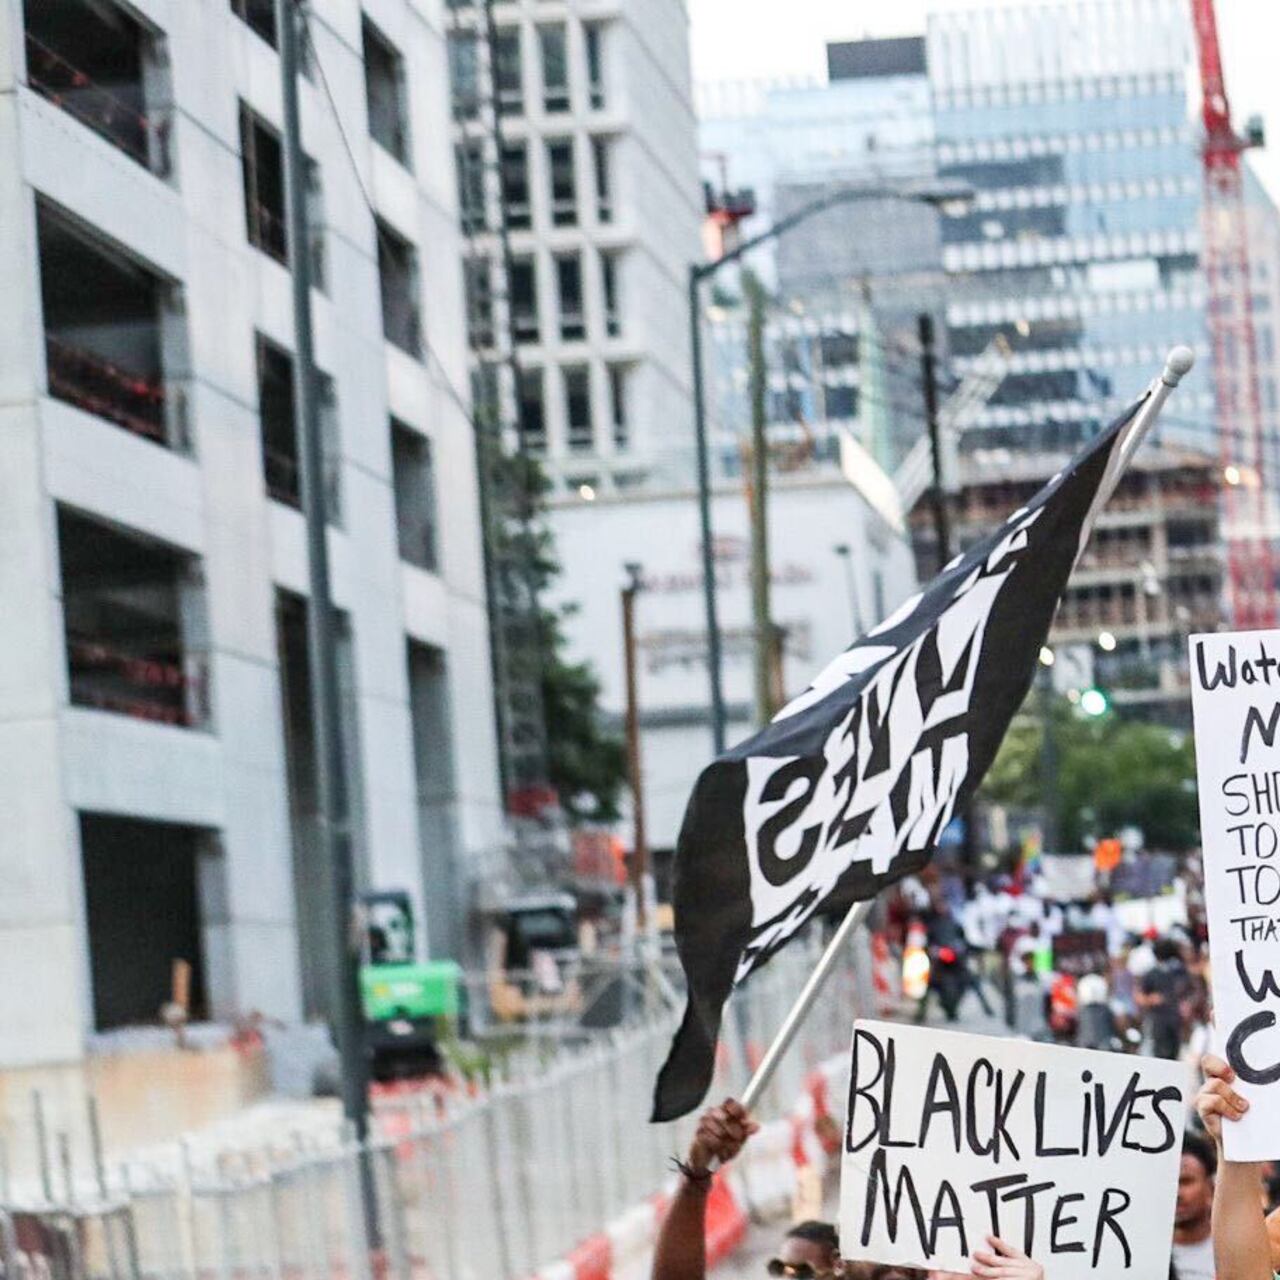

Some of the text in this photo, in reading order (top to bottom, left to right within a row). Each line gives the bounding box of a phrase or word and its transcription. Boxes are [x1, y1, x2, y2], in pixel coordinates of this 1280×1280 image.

[1226, 822, 1278, 859] TO
[1226, 864, 1280, 905] TO
[846, 1028, 1026, 1164] BLACK
[861, 1148, 1132, 1269] MATTER
